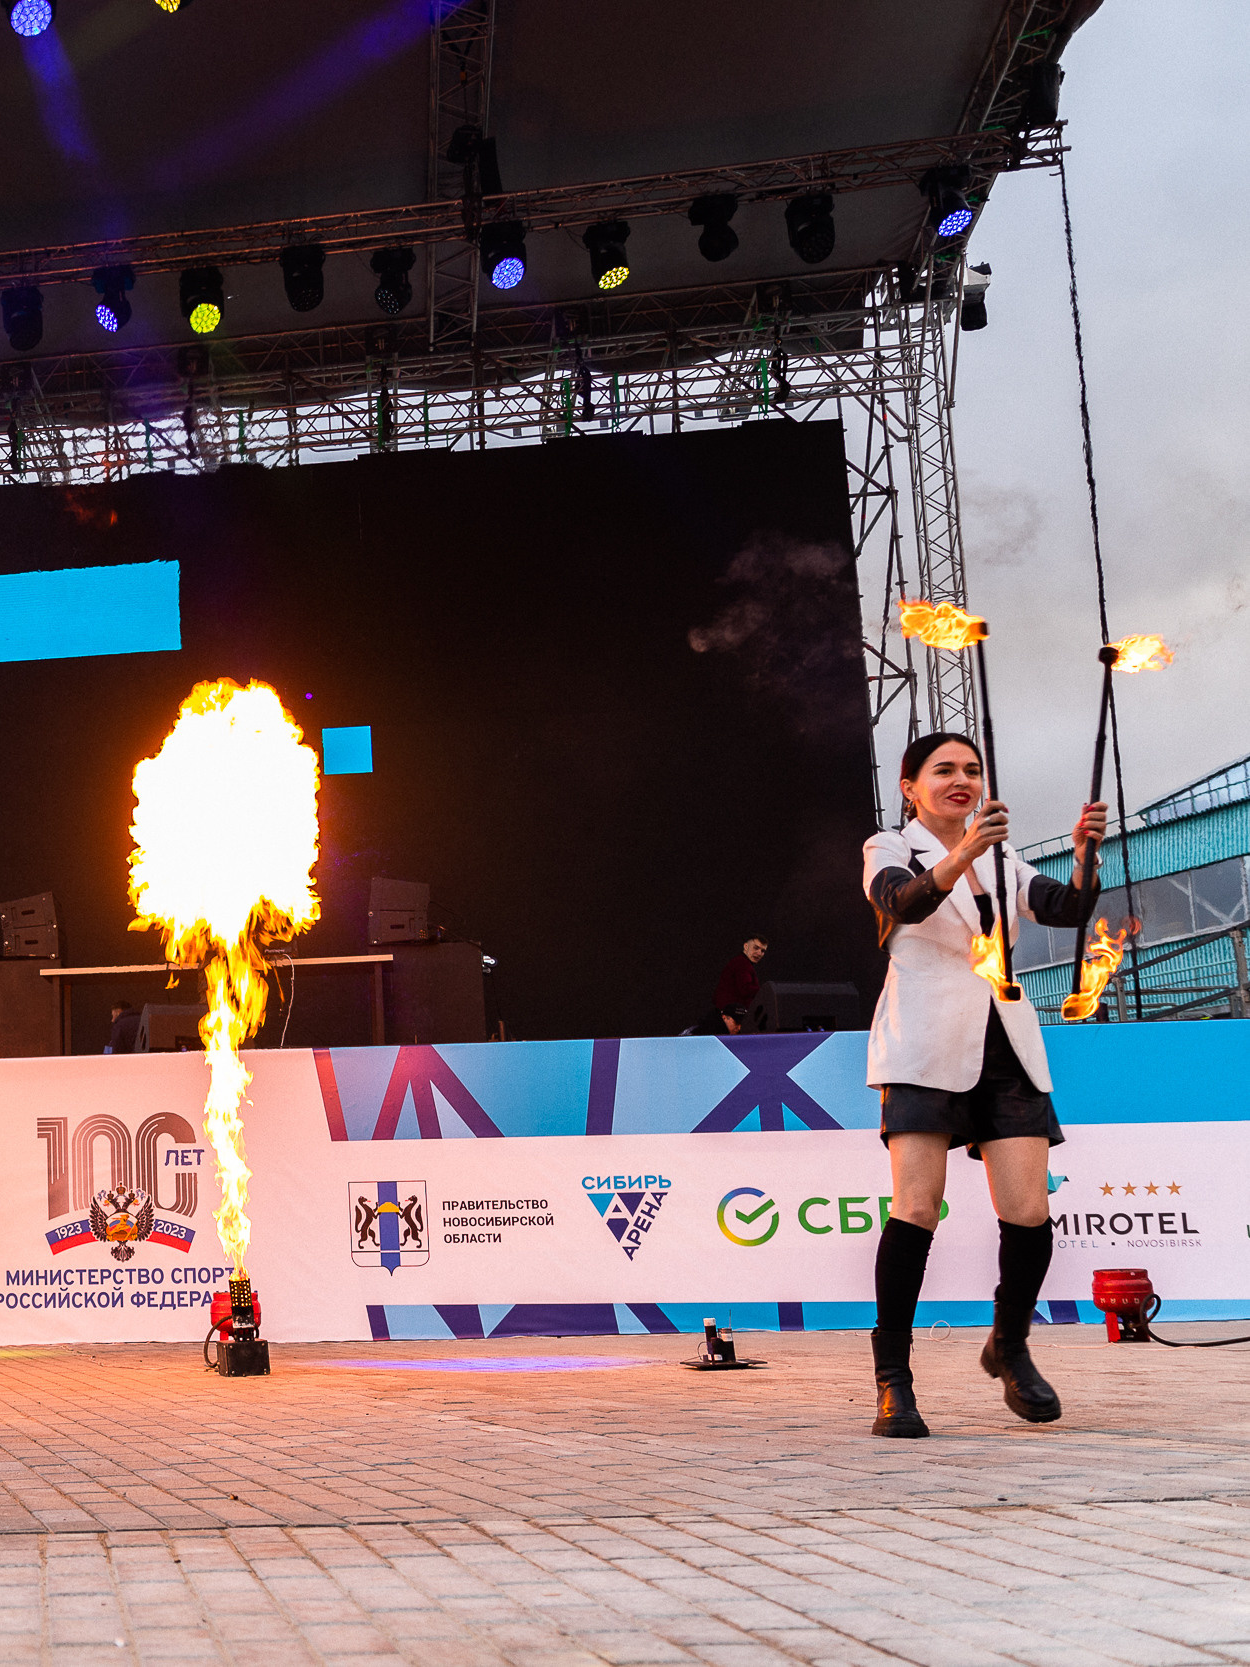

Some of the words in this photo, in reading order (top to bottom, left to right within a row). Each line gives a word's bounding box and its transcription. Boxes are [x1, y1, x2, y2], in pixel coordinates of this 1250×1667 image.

[164, 1149, 205, 1166] ЛЕТ
[582, 1175, 672, 1190] СИБИРЬ
[442, 1199, 548, 1211] ПРАВИТЕЛЬСТВО
[443, 1213, 554, 1227] НОВОСИБИРСКОЙ
[622, 1192, 668, 1261] АРЕНА
[1050, 1213, 1200, 1235] MIROTEL
[55, 1223, 83, 1239] 1923
[156, 1221, 187, 1239] 2023
[444, 1233, 502, 1244] ОБЛАСТИ
[1057, 1239, 1099, 1249] OTEL
[1127, 1239, 1202, 1248] NOVOSIBIRSK
[6, 1268, 164, 1286] МИНИСТЕРСТВО
[171, 1267, 242, 1284] СПОРТ
